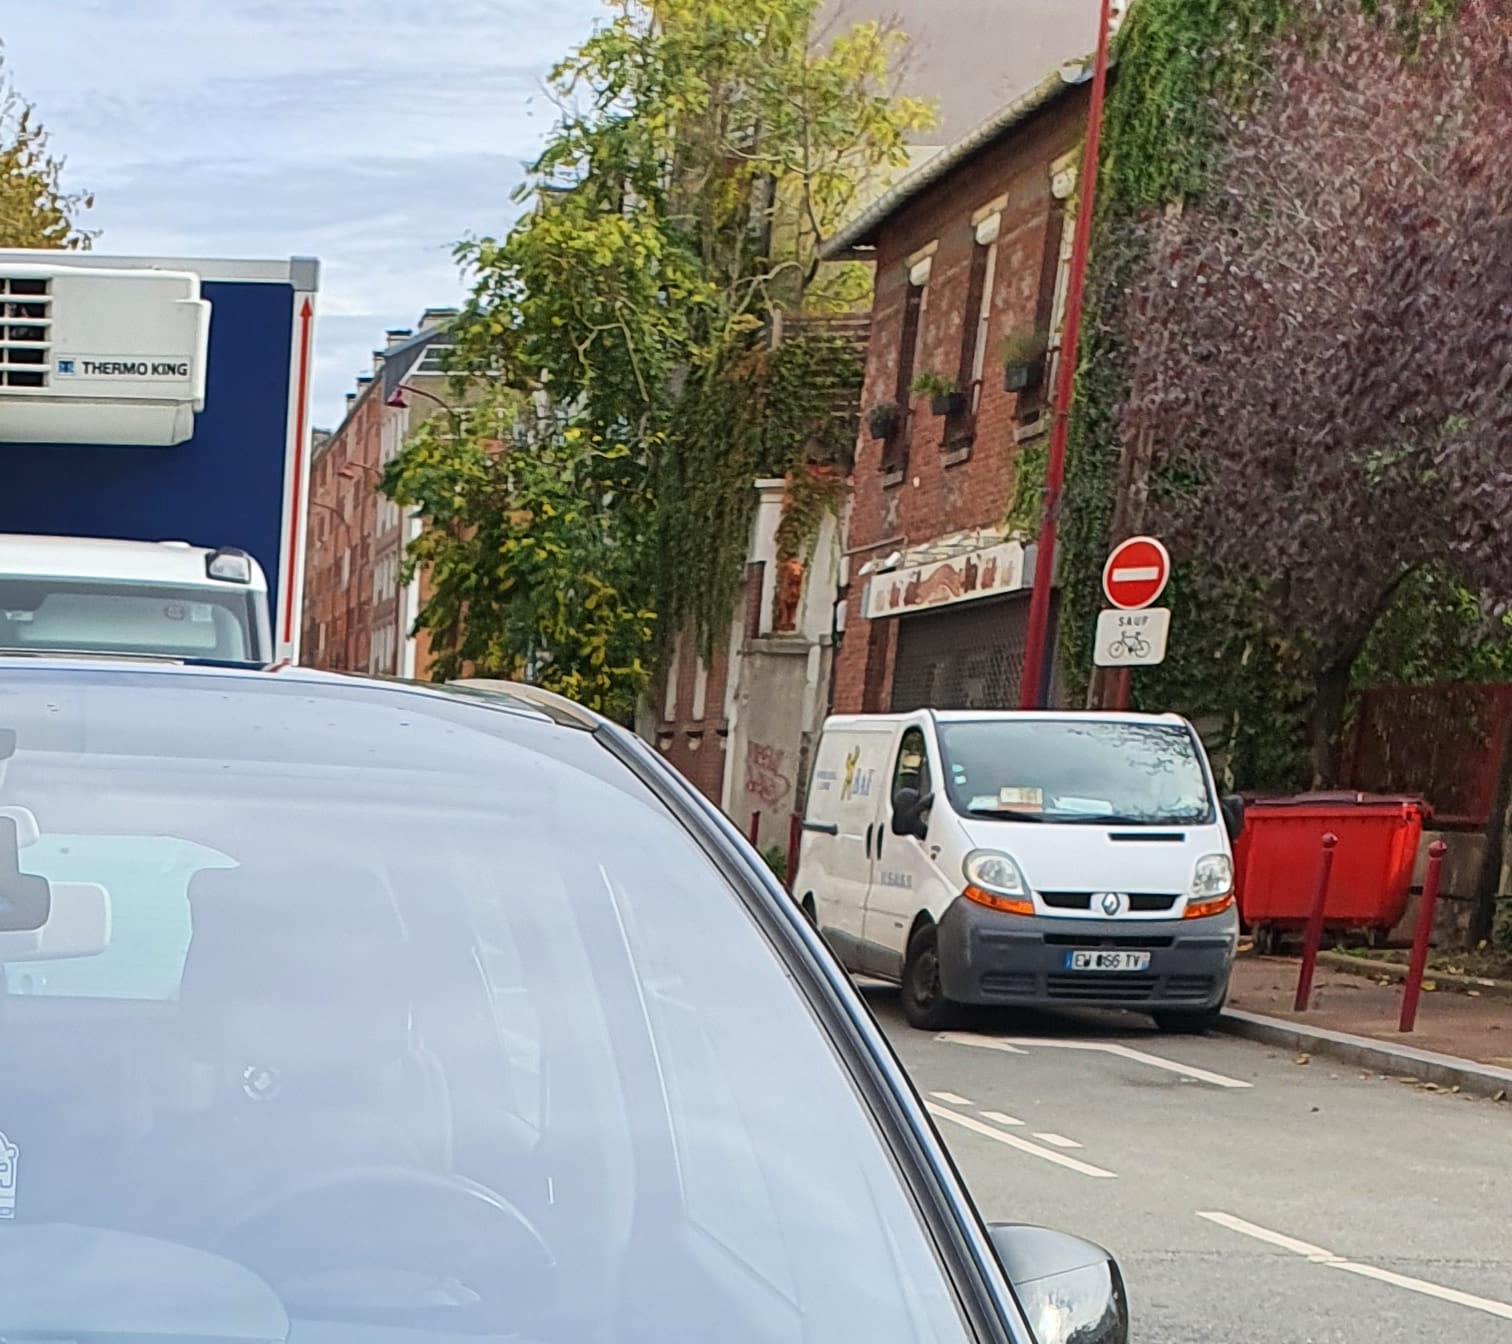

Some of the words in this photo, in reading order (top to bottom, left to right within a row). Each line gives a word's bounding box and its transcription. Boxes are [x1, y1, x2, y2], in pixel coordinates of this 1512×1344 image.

[82, 361, 148, 375] THERMO
[151, 362, 188, 376] KING
[1118, 615, 1149, 627] SAUF
